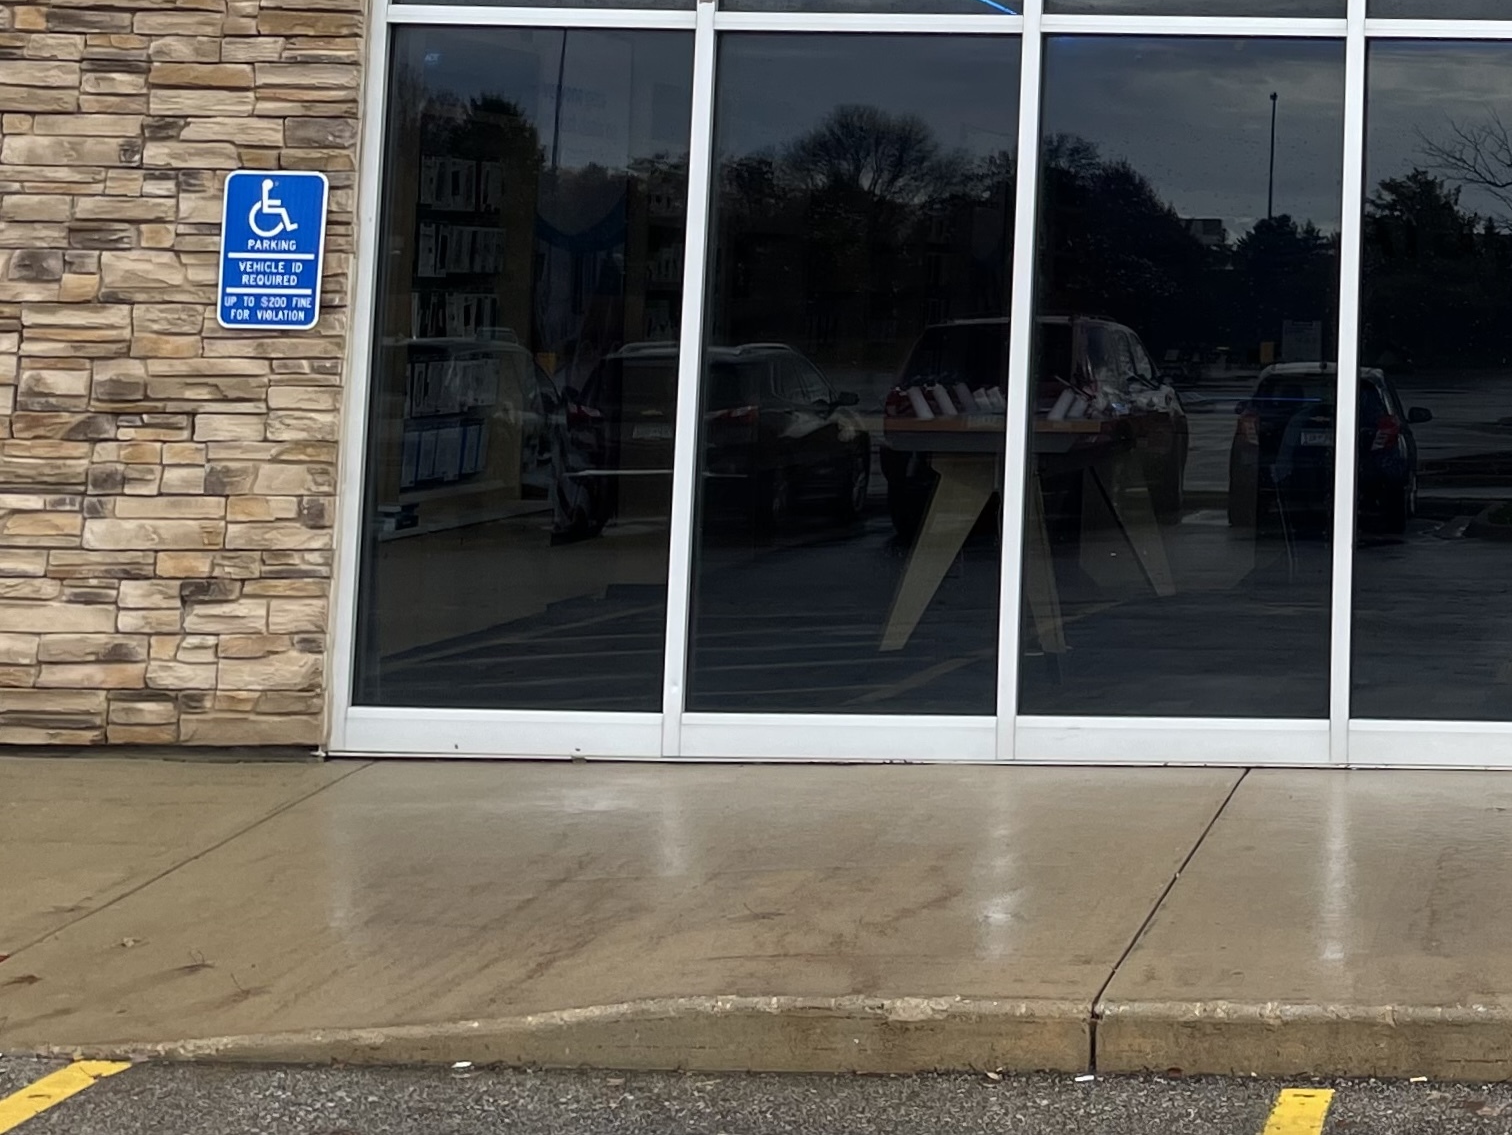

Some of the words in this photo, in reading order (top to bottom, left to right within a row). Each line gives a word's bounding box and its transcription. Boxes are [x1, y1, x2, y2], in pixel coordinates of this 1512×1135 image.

[247, 239, 296, 251] PARKING
[239, 261, 285, 273] VEHICLE
[291, 262, 303, 273] ID
[242, 274, 298, 286] REQUIRED
[224, 296, 237, 307] UP
[243, 296, 255, 307] TO
[260, 296, 287, 308] $200
[292, 297, 312, 308] FINE
[230, 309, 250, 321] FOR
[256, 309, 305, 321] VIOLATION
